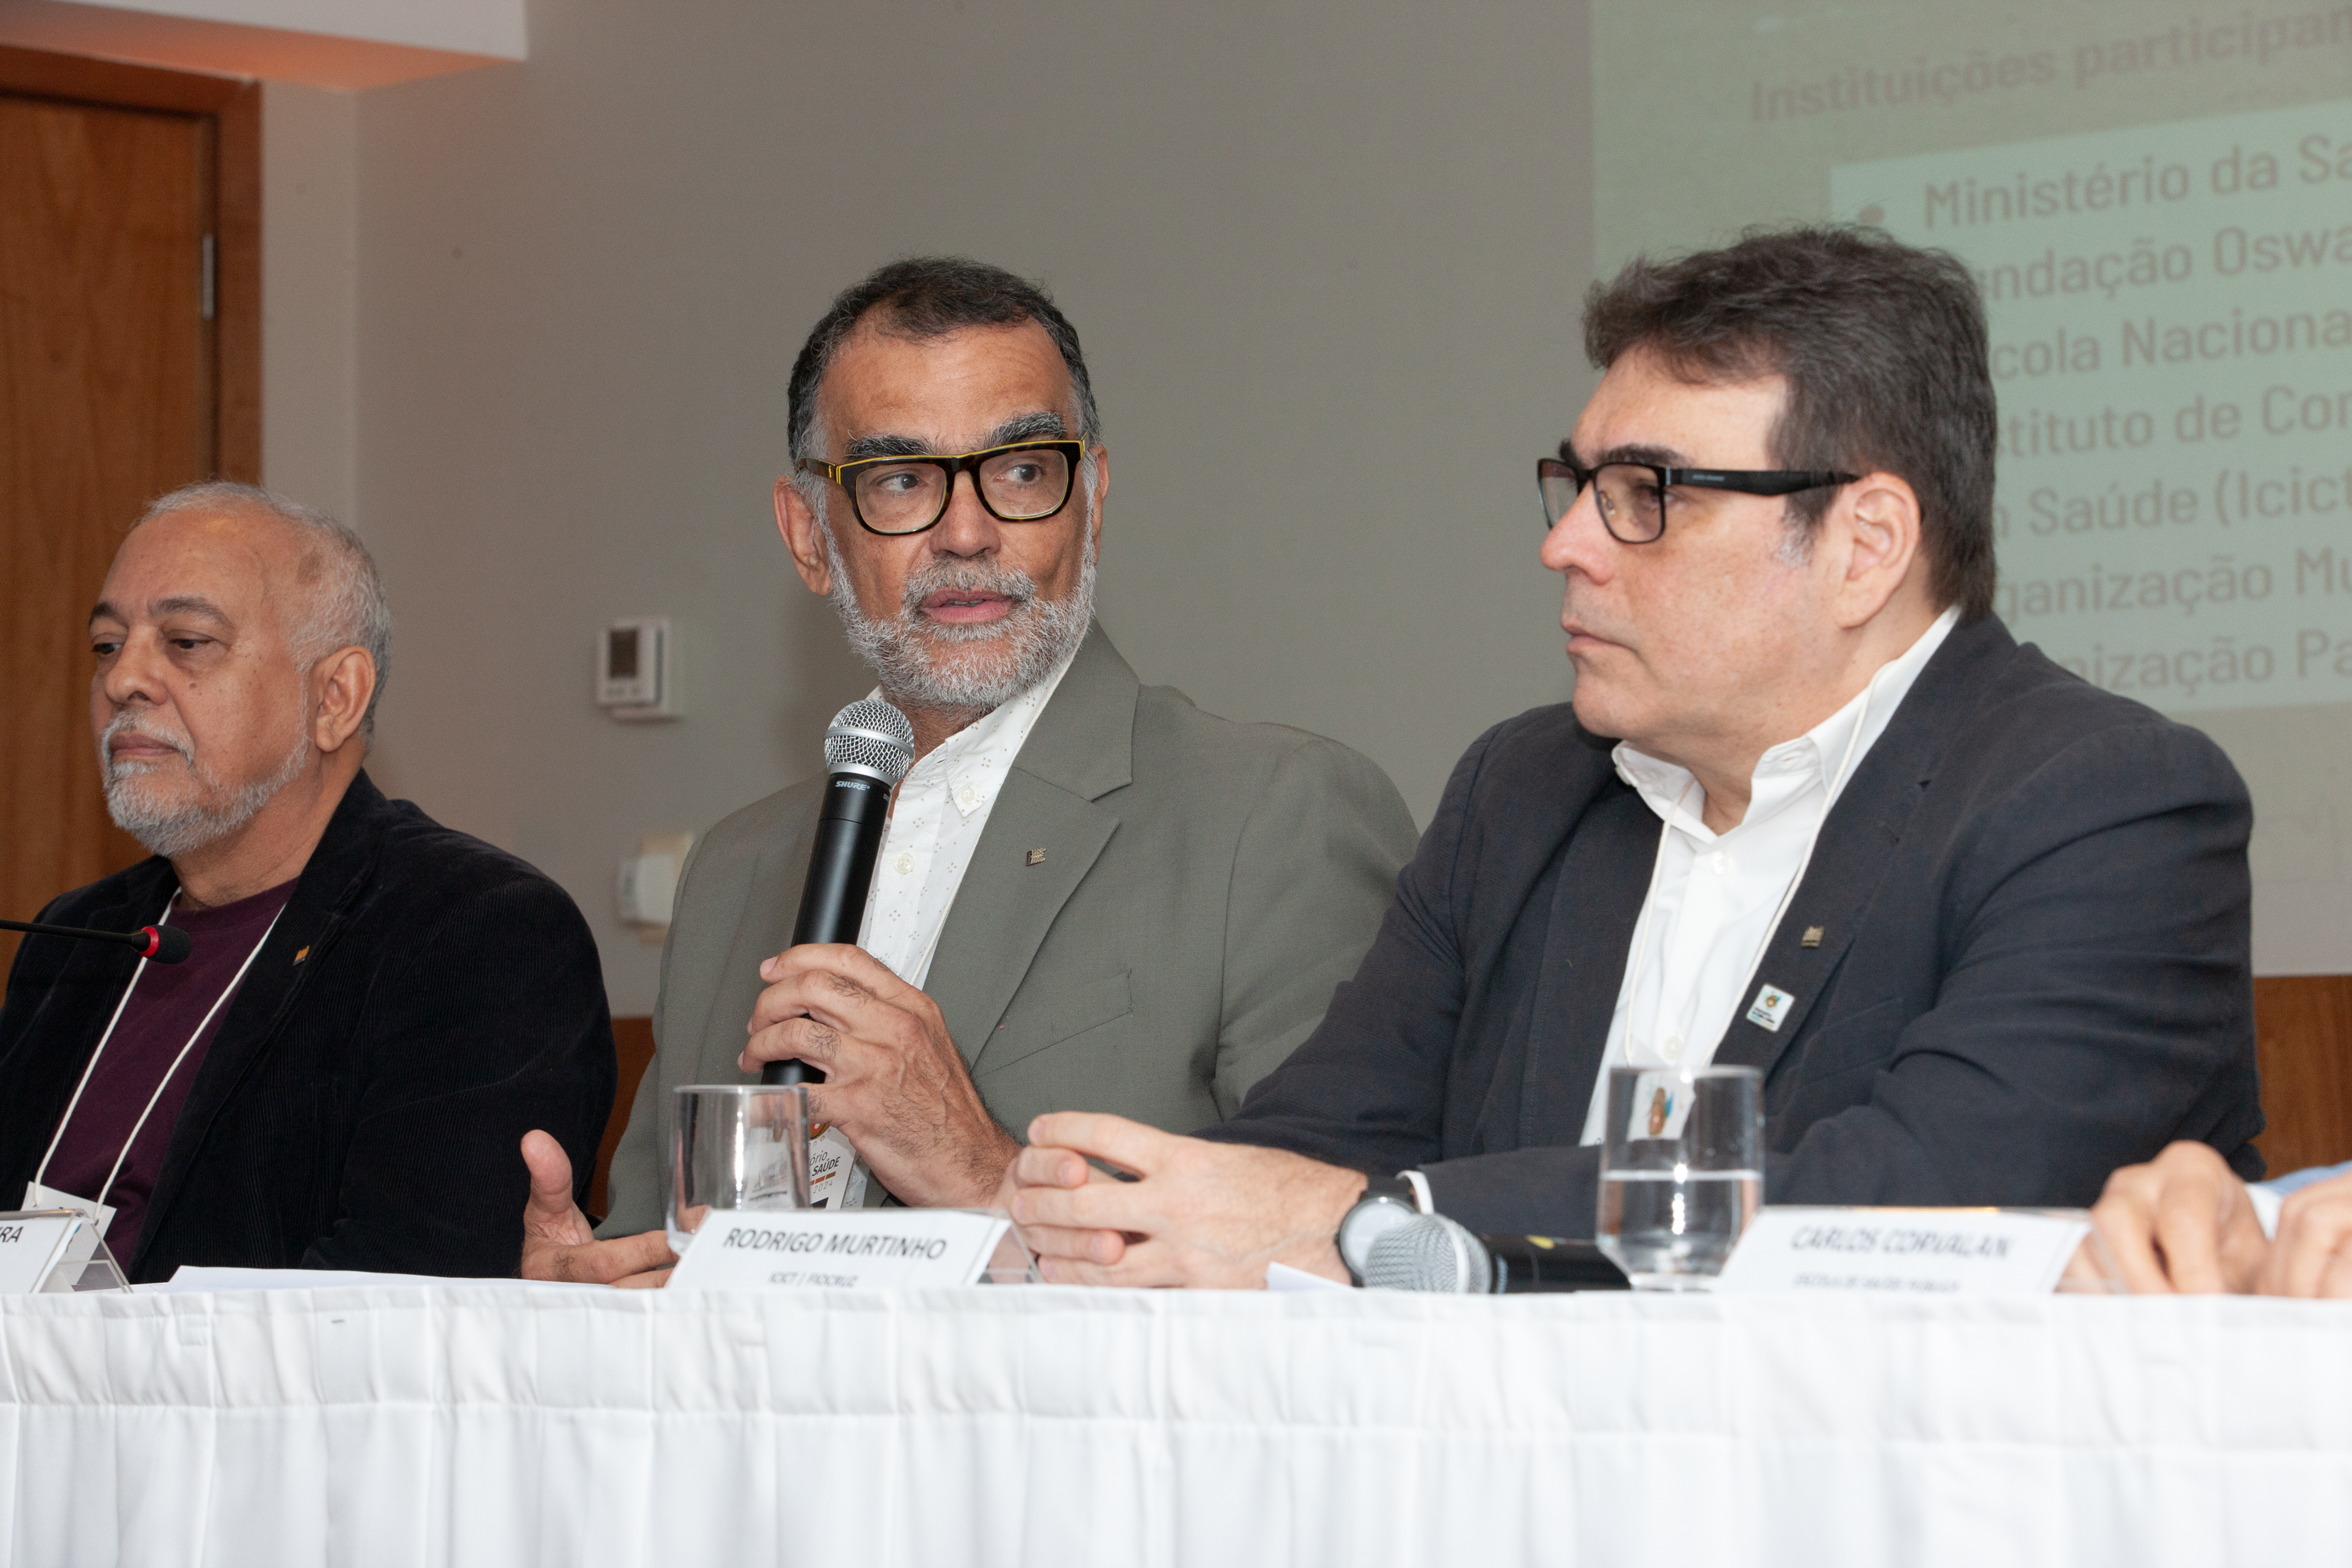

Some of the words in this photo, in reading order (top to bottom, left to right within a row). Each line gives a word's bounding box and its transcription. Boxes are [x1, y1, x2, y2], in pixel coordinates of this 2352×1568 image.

[1751, 49, 2056, 122] Instituições
[2074, 5, 2352, 89] participan
[1925, 155, 2190, 229] Ministério
[2210, 144, 2278, 195] da
[2298, 133, 2352, 185] Sa
[1979, 237, 2193, 300] ndação
[2213, 223, 2352, 277] Oswa
[1991, 326, 2101, 381] cola
[2121, 307, 2352, 368] Naciona
[1997, 406, 2153, 458] tituto
[2174, 394, 2241, 444] de
[2028, 479, 2198, 537] Saúde
[2215, 466, 2352, 527] (Icict
[1995, 554, 2273, 622] ganização
[2296, 630, 2352, 679] Pa
[835, 780, 867, 791] SHURE
[810, 1150, 828, 1167] ório
[811, 1156, 840, 1177] SAÚDE
[813, 1181, 833, 1194] 2024
[0, 1226, 24, 1243] RA
[724, 1228, 823, 1254] RODRIGO
[823, 1232, 947, 1260] MURTINHO
